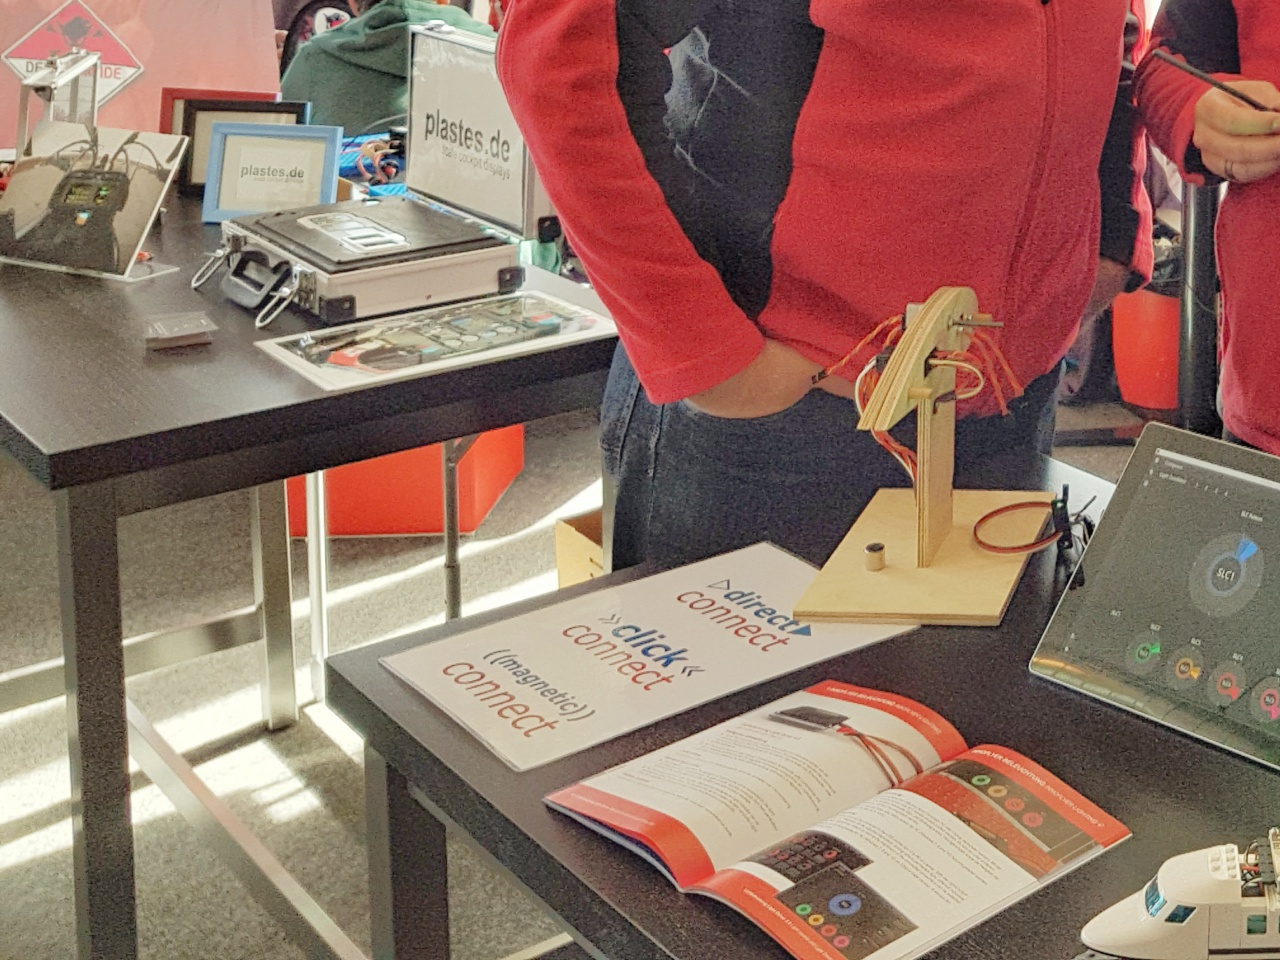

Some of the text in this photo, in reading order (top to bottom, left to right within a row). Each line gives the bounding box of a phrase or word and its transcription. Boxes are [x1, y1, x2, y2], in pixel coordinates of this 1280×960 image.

[423, 108, 511, 163] plastes.de
[240, 164, 305, 179] plastes.de
[676, 589, 791, 653] connect
[723, 588, 800, 634] direct
[561, 623, 676, 692] connect
[441, 661, 557, 739] connect
